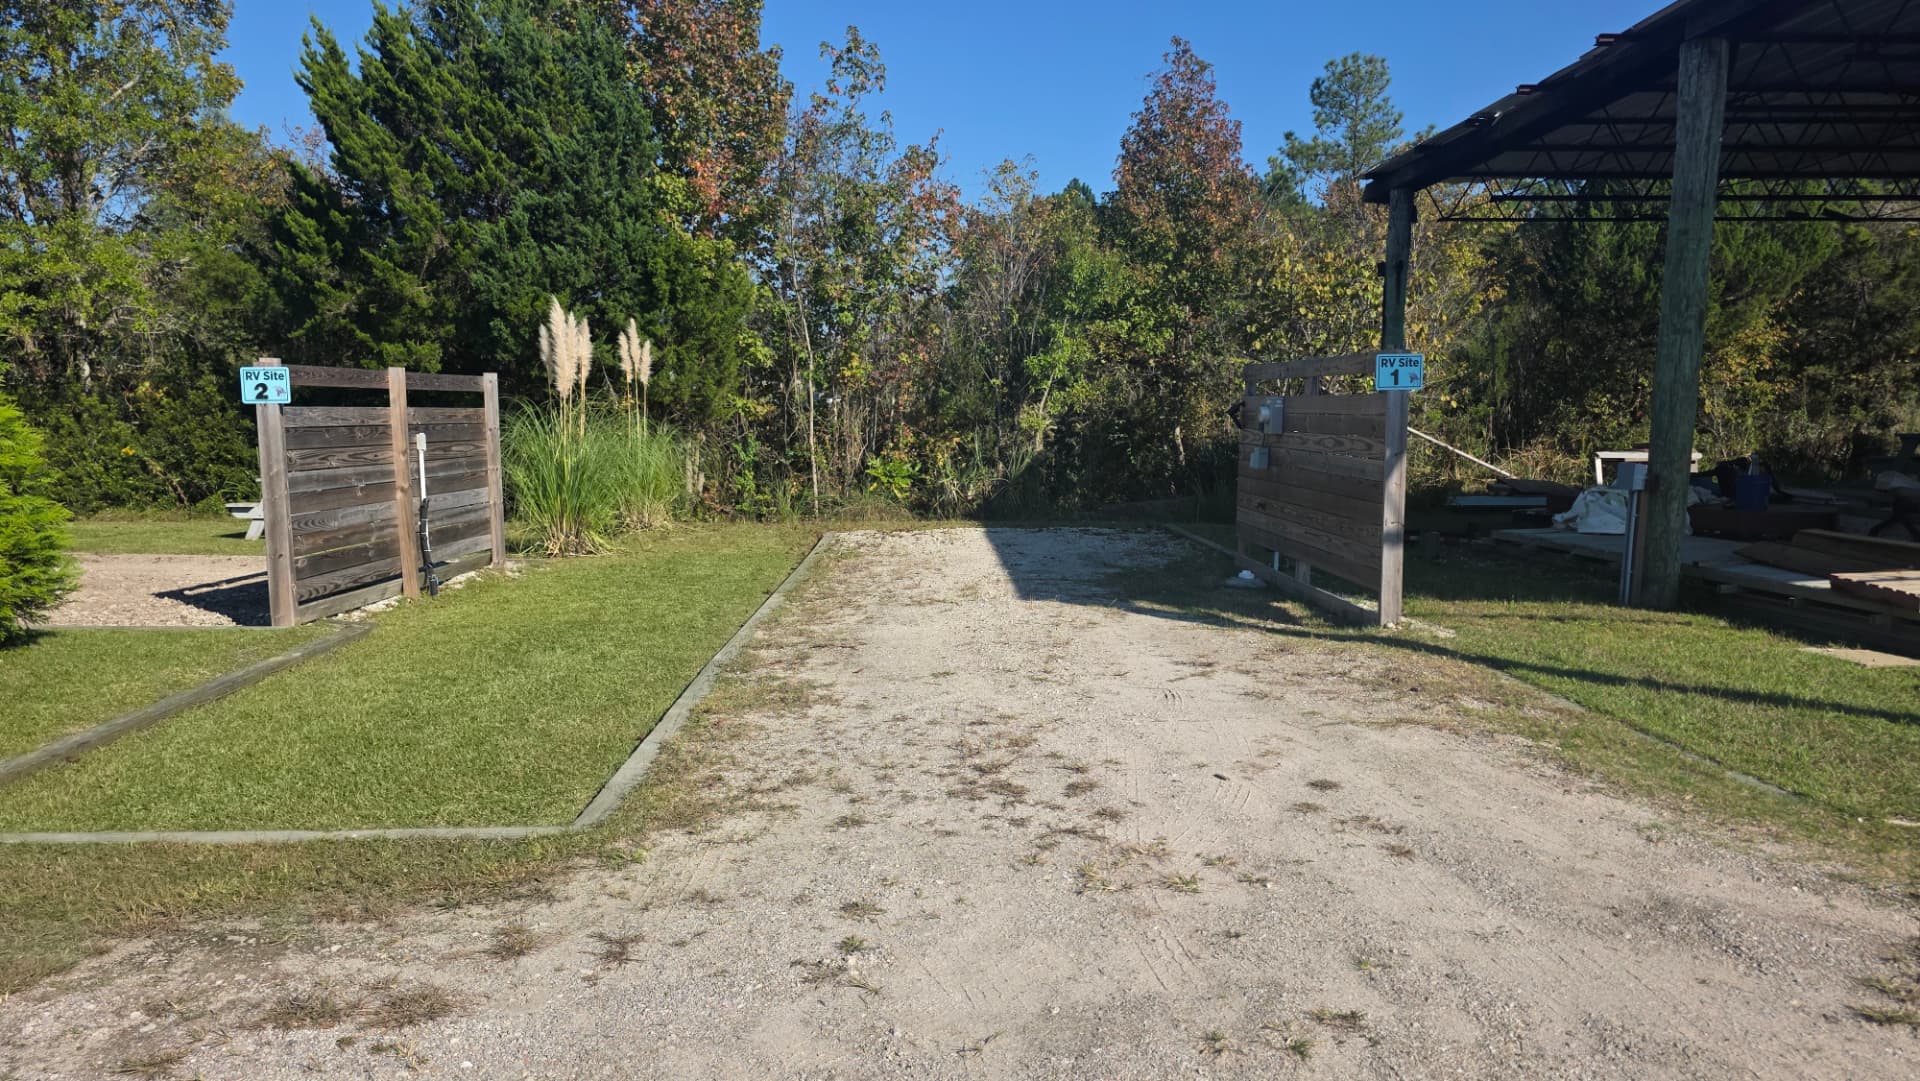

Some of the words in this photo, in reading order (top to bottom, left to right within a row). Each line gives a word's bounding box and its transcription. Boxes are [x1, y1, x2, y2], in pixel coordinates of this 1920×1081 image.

[1381, 358, 1396, 368] RV
[1398, 358, 1419, 367] Site
[245, 371, 260, 380] RV
[263, 371, 284, 380] Site
[1390, 369, 1399, 385] 1
[254, 383, 268, 399] 2
